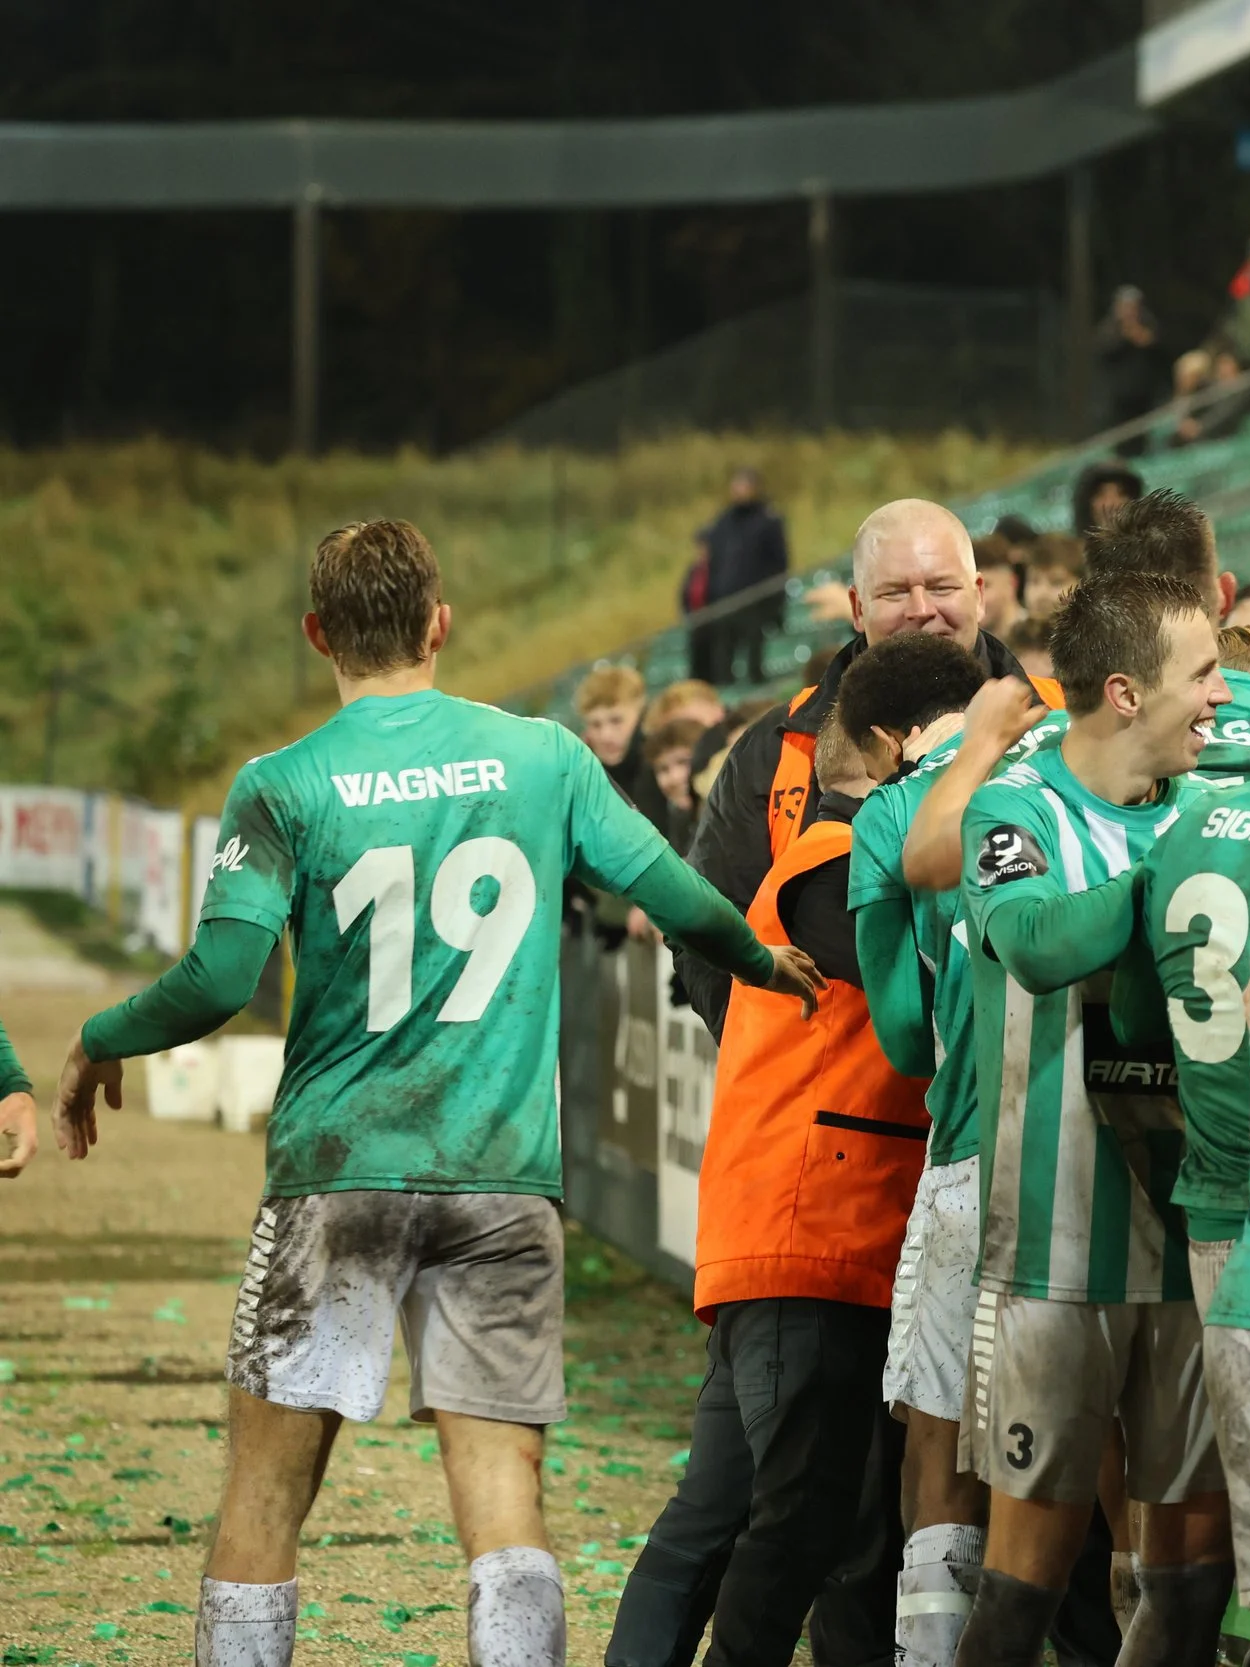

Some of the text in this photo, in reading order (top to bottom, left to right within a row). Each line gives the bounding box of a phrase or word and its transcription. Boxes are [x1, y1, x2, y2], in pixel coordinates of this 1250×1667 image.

[330, 759, 508, 807] WAGNER
[986, 862, 1037, 886] DIVISION
[332, 836, 537, 1033] 19
[1165, 872, 1250, 1064] 3
[1006, 1423, 1034, 1470] 3
